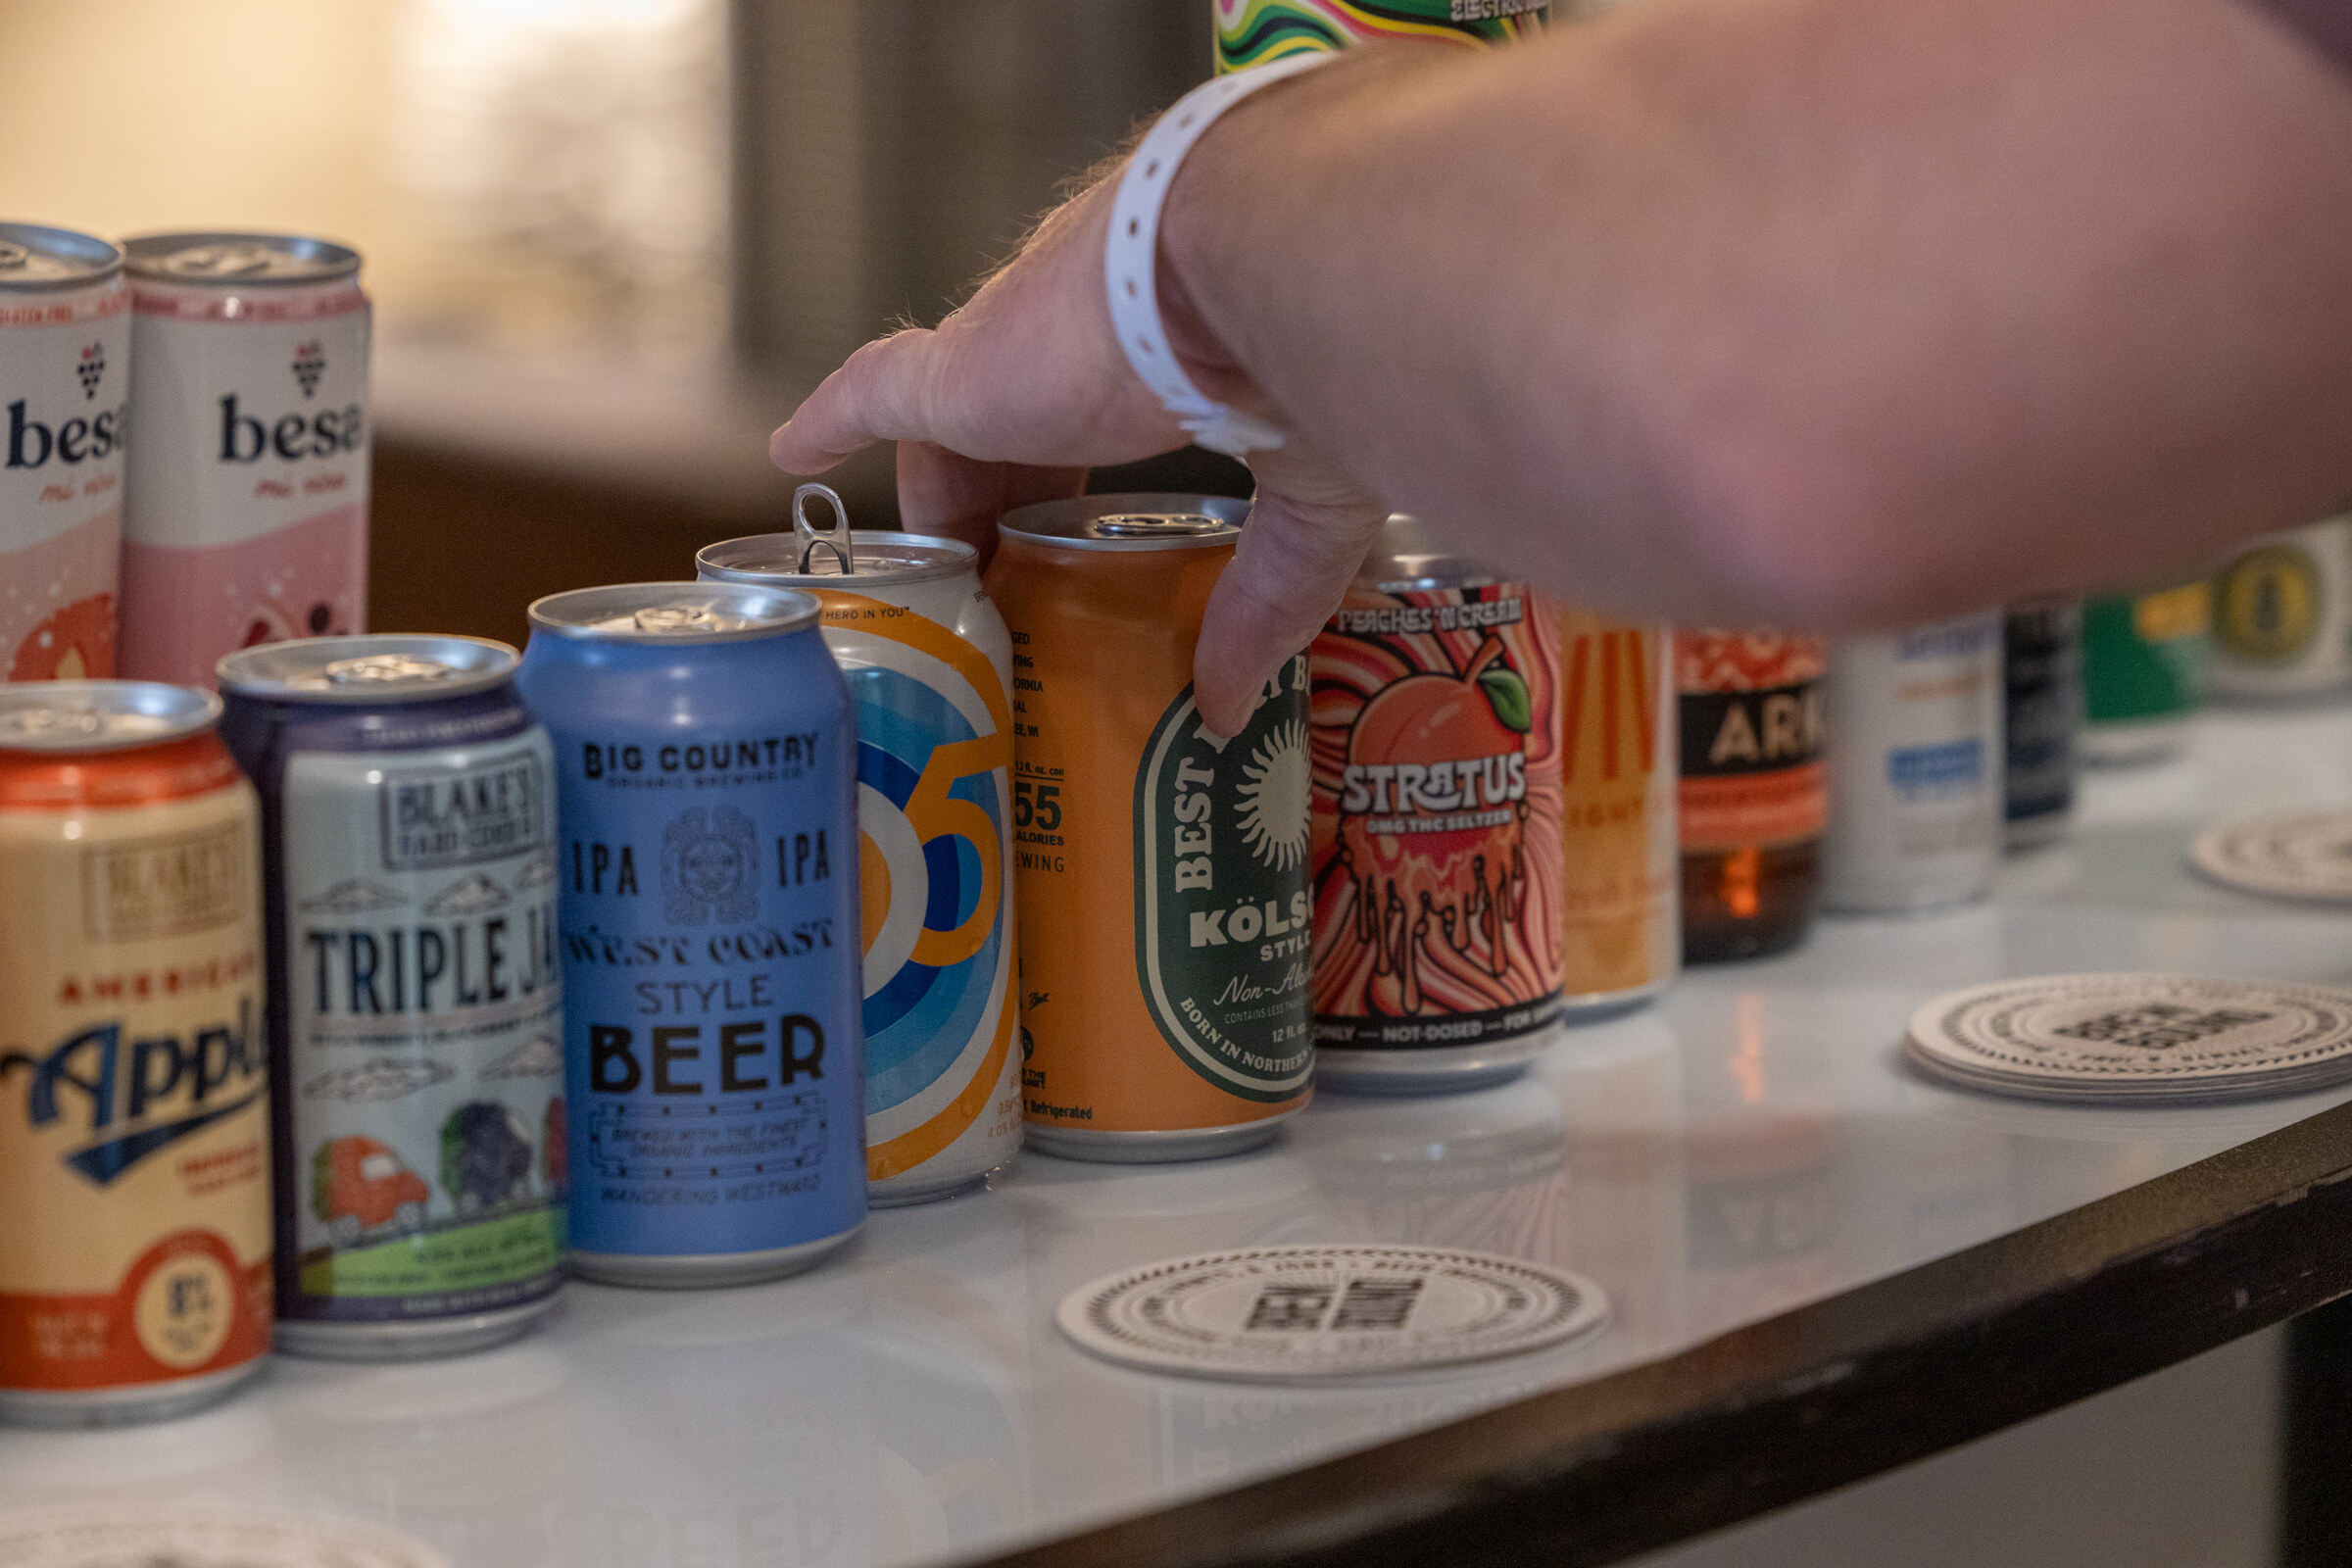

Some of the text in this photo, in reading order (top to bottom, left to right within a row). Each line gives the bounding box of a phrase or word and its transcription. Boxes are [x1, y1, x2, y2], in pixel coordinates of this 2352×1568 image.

[825, 609, 859, 620] HERO
[863, 608, 876, 619] IN
[1338, 607, 1434, 634] PEACHES
[1011, 631, 1030, 646] GED
[1013, 677, 1044, 692] ORNIA
[584, 732, 819, 779] BIG COUNTRY
[1015, 781, 1062, 831] 55
[1343, 751, 1527, 814] STRATUS
[1015, 830, 1064, 847] ALORIES
[1174, 757, 1215, 894] BEST
[573, 840, 639, 896] IPA
[777, 829, 831, 888] IPA
[1190, 885, 1314, 949] KÖLS
[308, 917, 508, 1014] TRIPLE
[568, 919, 833, 966] WEST COAST
[635, 973, 774, 1015] STYLE
[1225, 1007, 1265, 1024] CONTAINS
[1267, 1004, 1284, 1017] LESS
[1180, 997, 1222, 1045] BORN
[1220, 1039, 1242, 1060] IN
[1272, 1028, 1284, 1044] 12
[590, 1013, 826, 1096] BEER
[1031, 1099, 1093, 1120] Refrigerated
